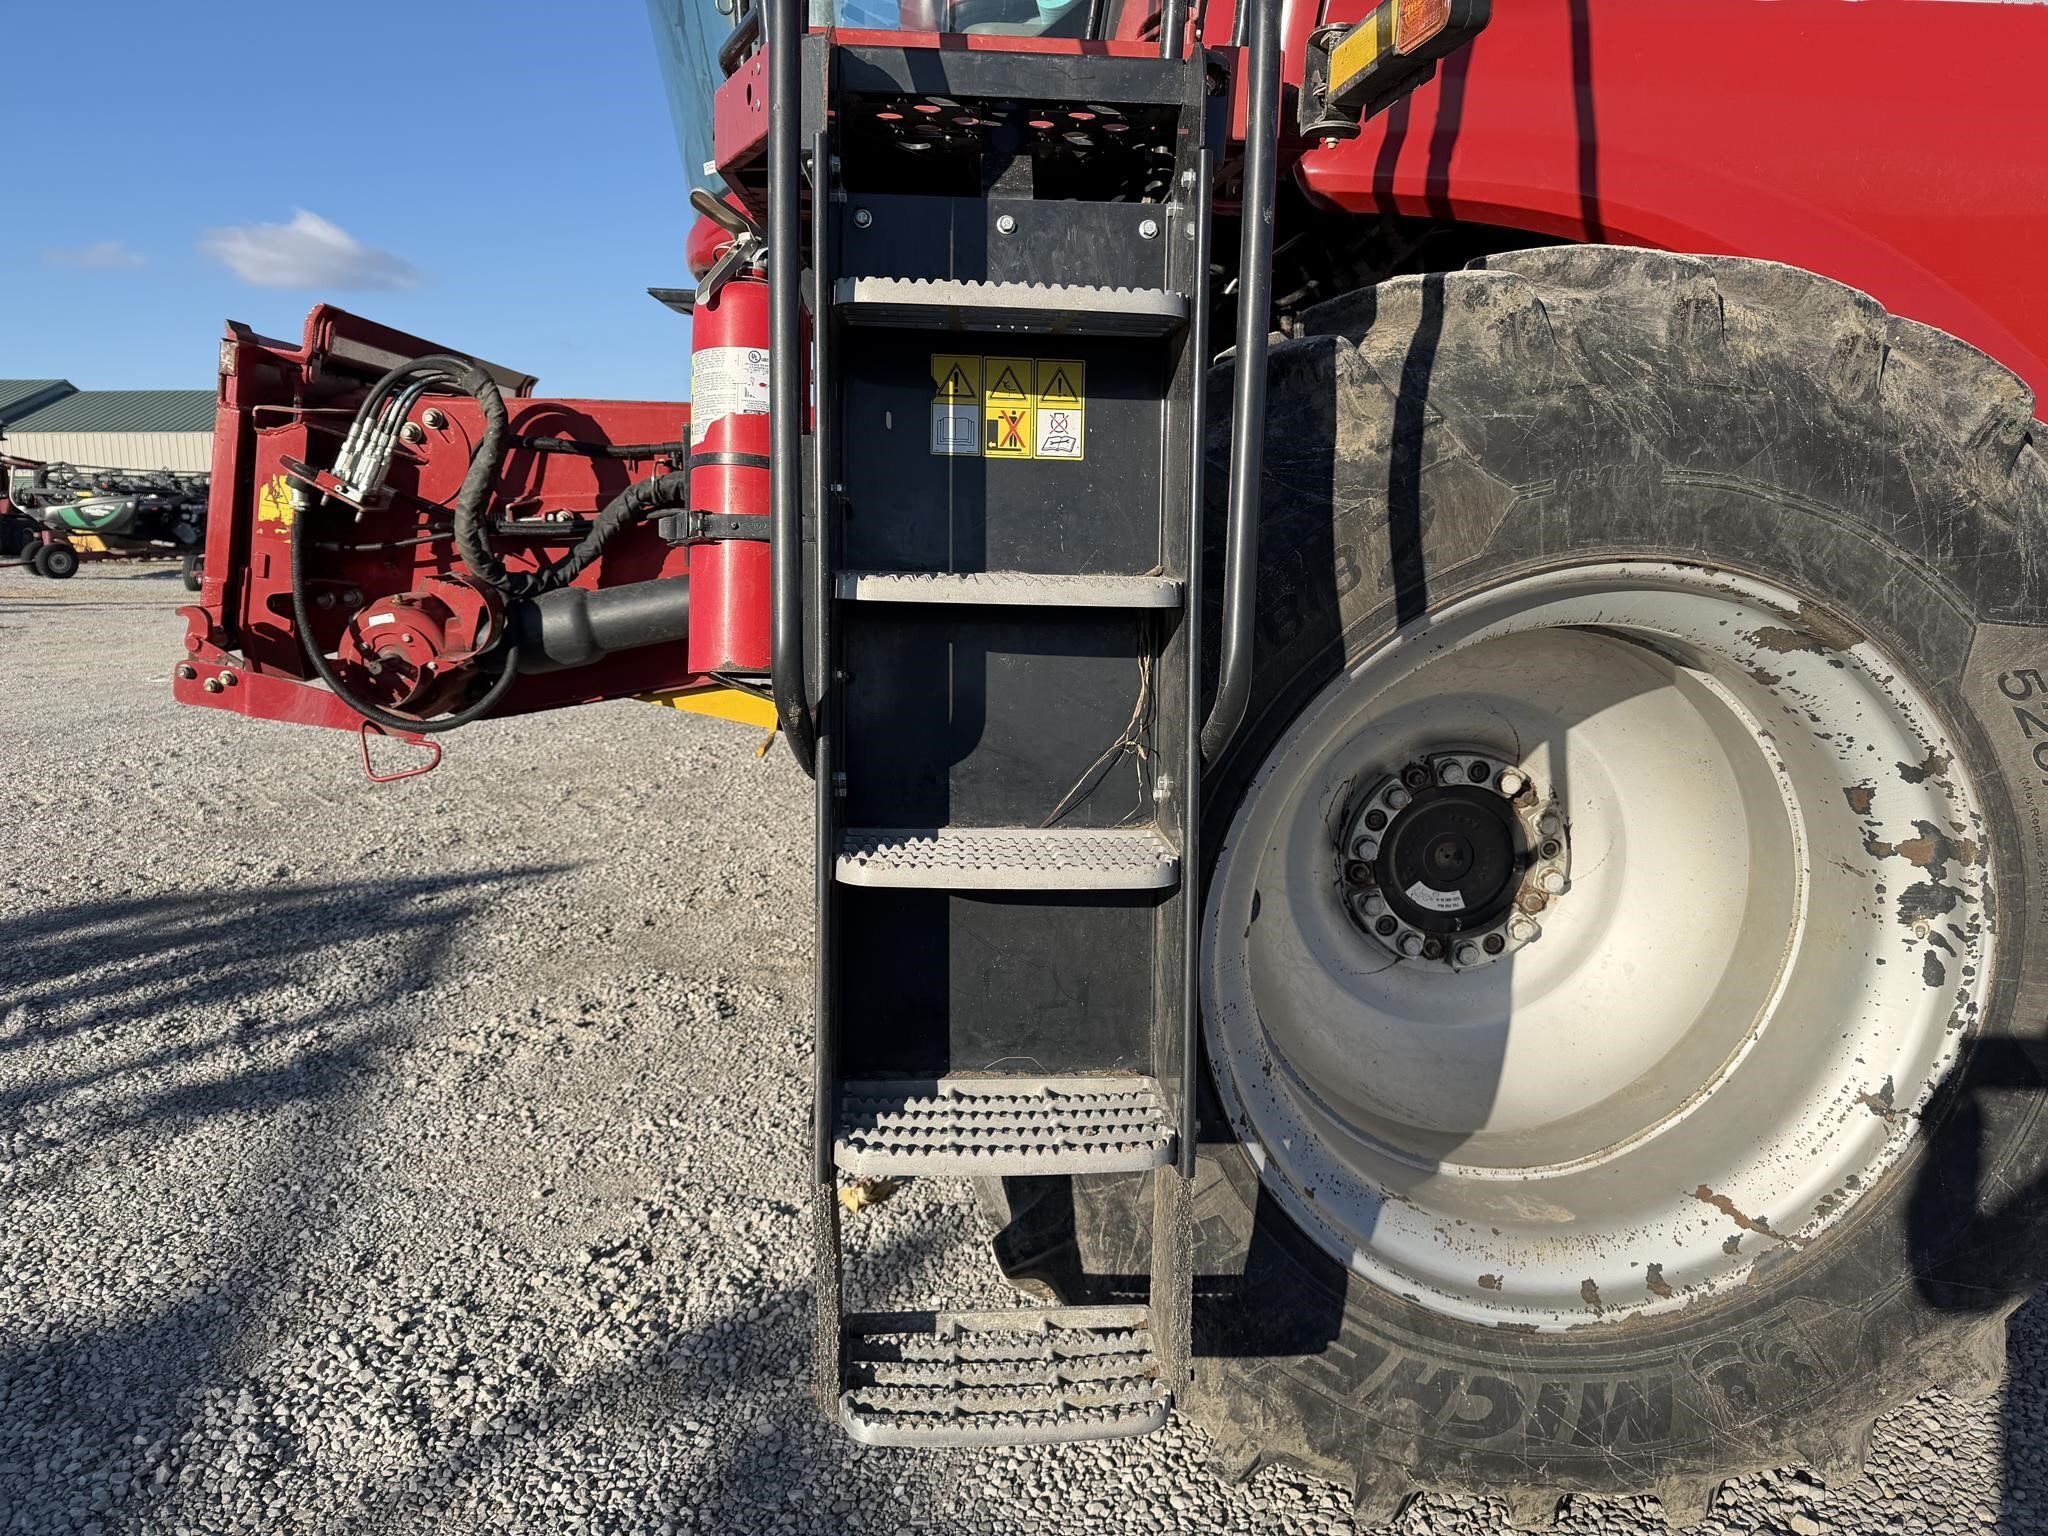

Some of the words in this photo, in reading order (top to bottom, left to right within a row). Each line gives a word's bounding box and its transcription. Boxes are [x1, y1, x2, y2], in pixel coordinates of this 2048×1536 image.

[1870, 615, 1922, 662] MICHELIN
[2018, 776, 2035, 806] (May
[2030, 807, 2045, 858] Replace
